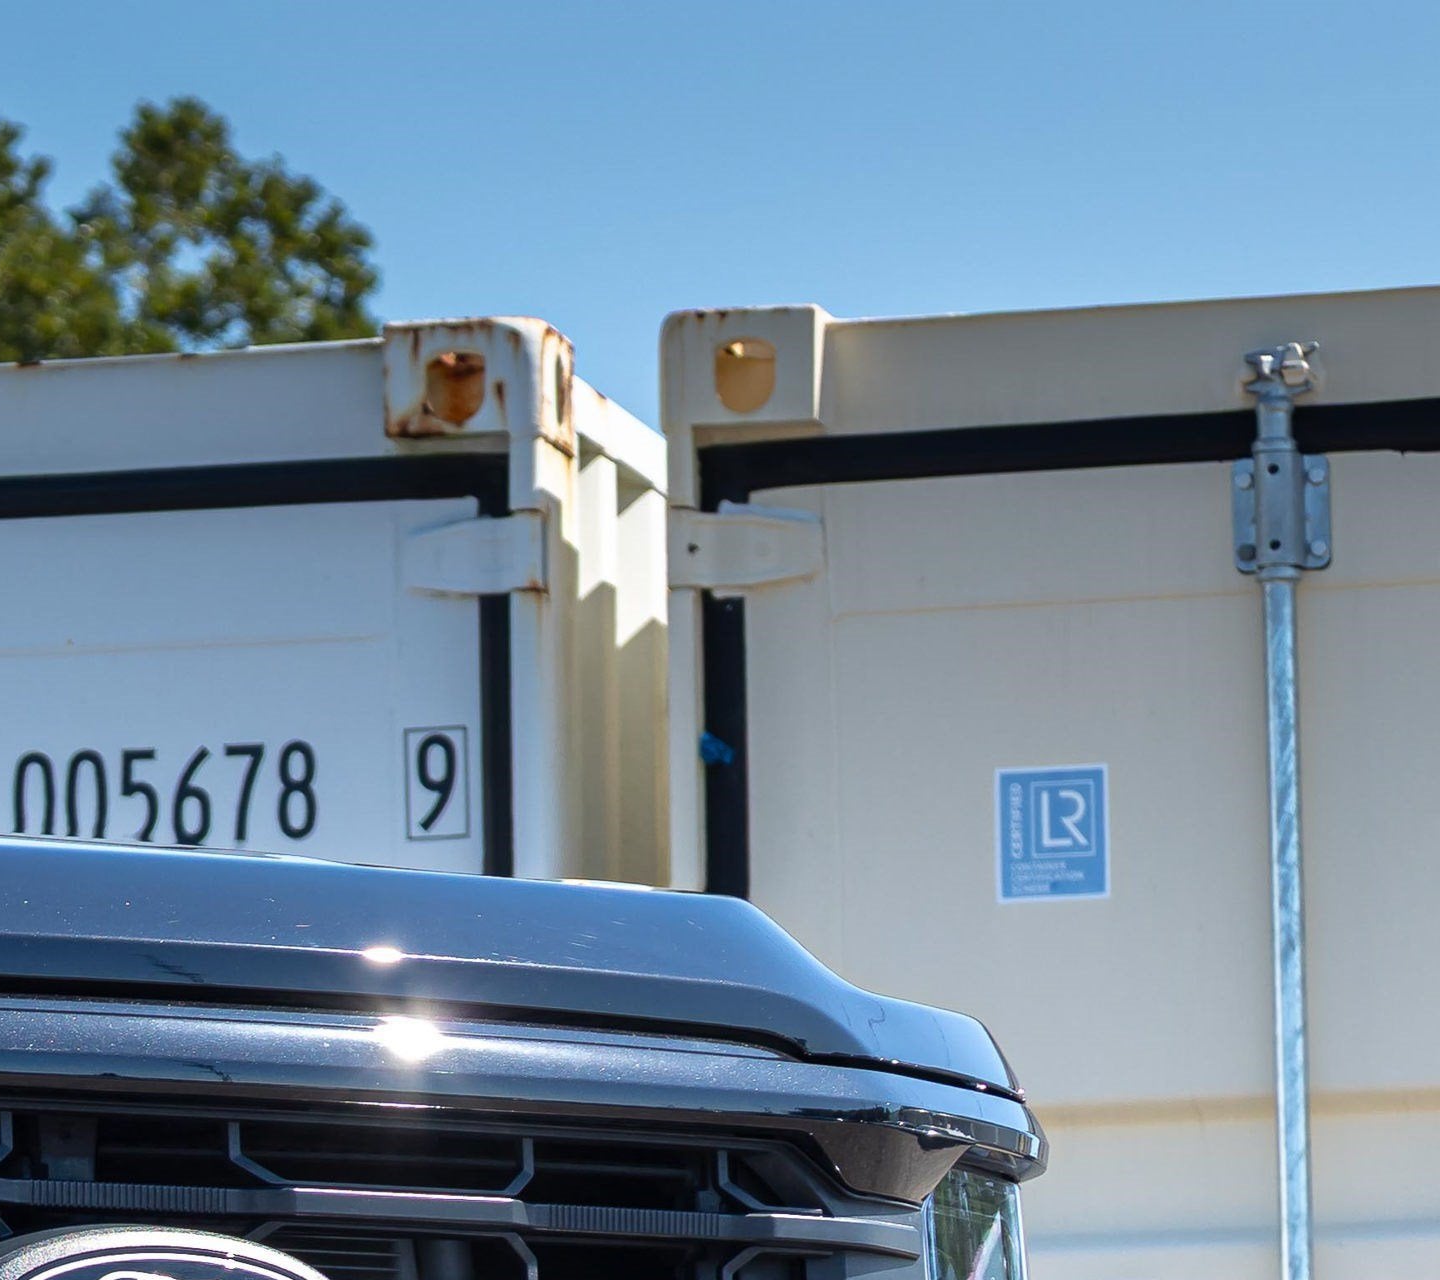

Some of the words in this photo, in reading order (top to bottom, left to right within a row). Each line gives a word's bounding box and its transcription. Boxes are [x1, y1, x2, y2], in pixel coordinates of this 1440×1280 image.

[13, 739, 317, 845] 005678
[416, 732, 457, 832] 9
[1041, 790, 1090, 847] LR
